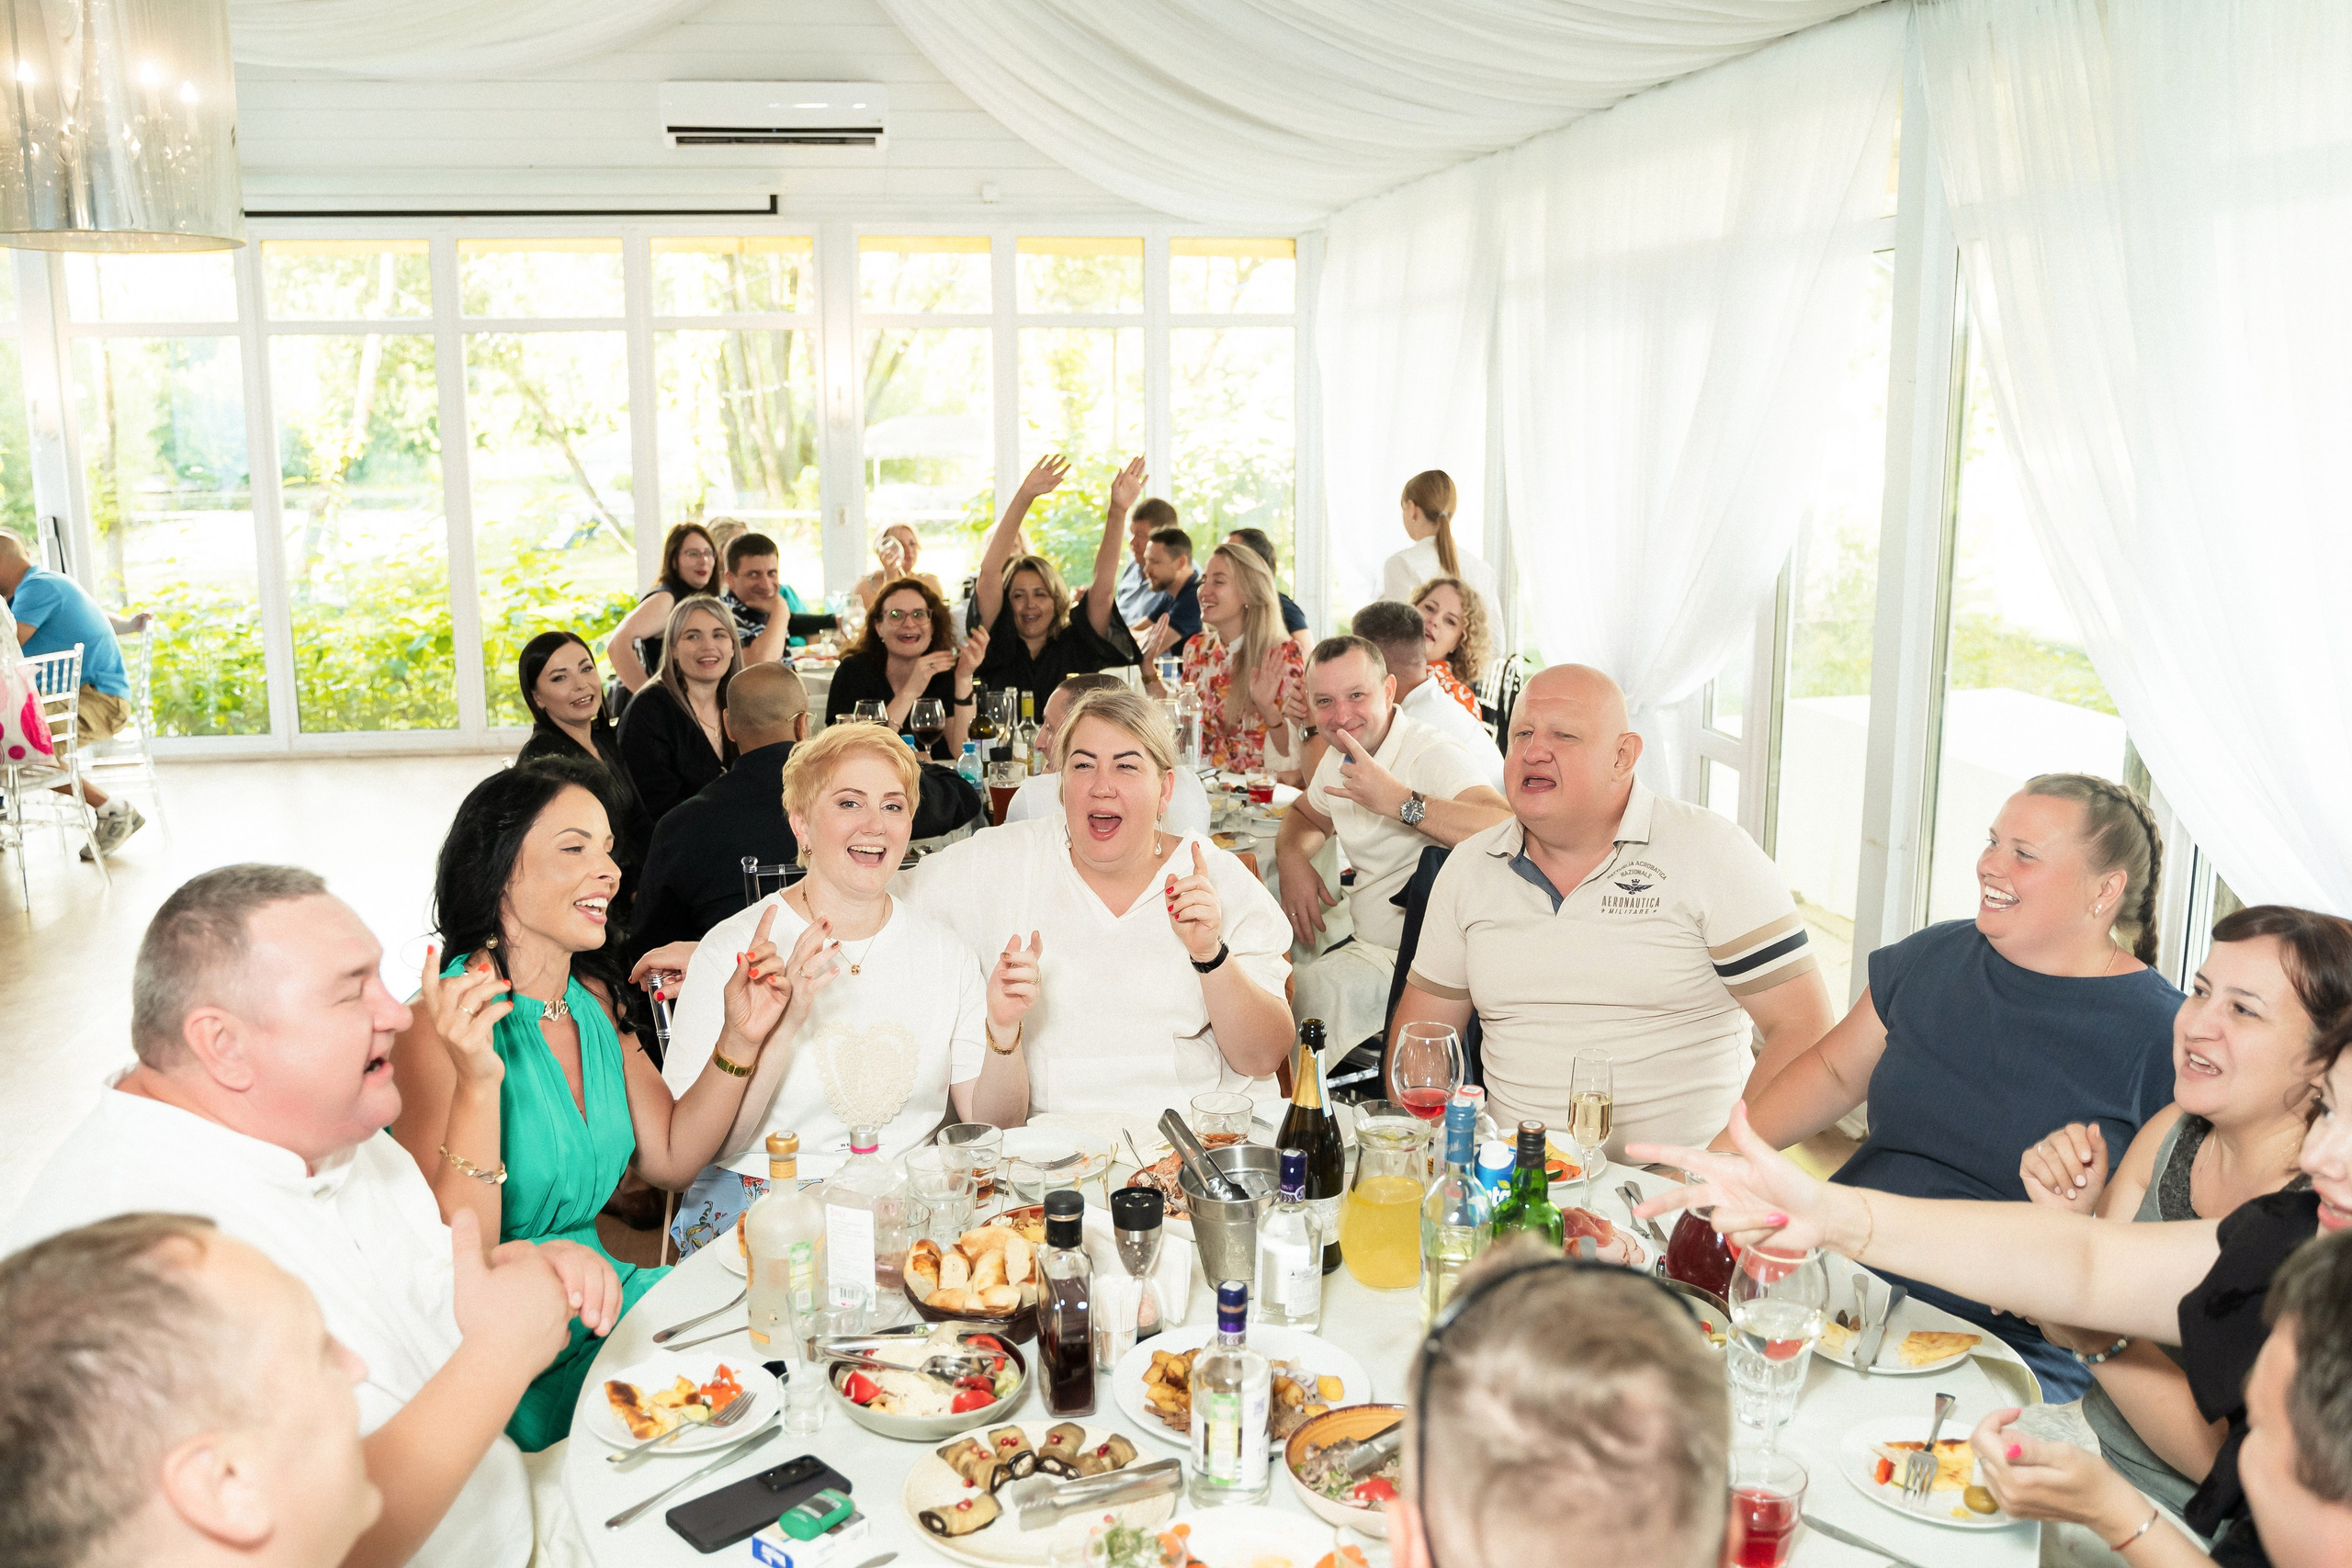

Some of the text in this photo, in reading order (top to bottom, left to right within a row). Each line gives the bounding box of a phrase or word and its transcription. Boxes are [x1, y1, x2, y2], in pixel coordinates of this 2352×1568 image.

[1620, 869, 1653, 879] NAZIONALE
[1635, 861, 1668, 881] ACROBATICA
[1601, 895, 1660, 908] AERONAUTICA
